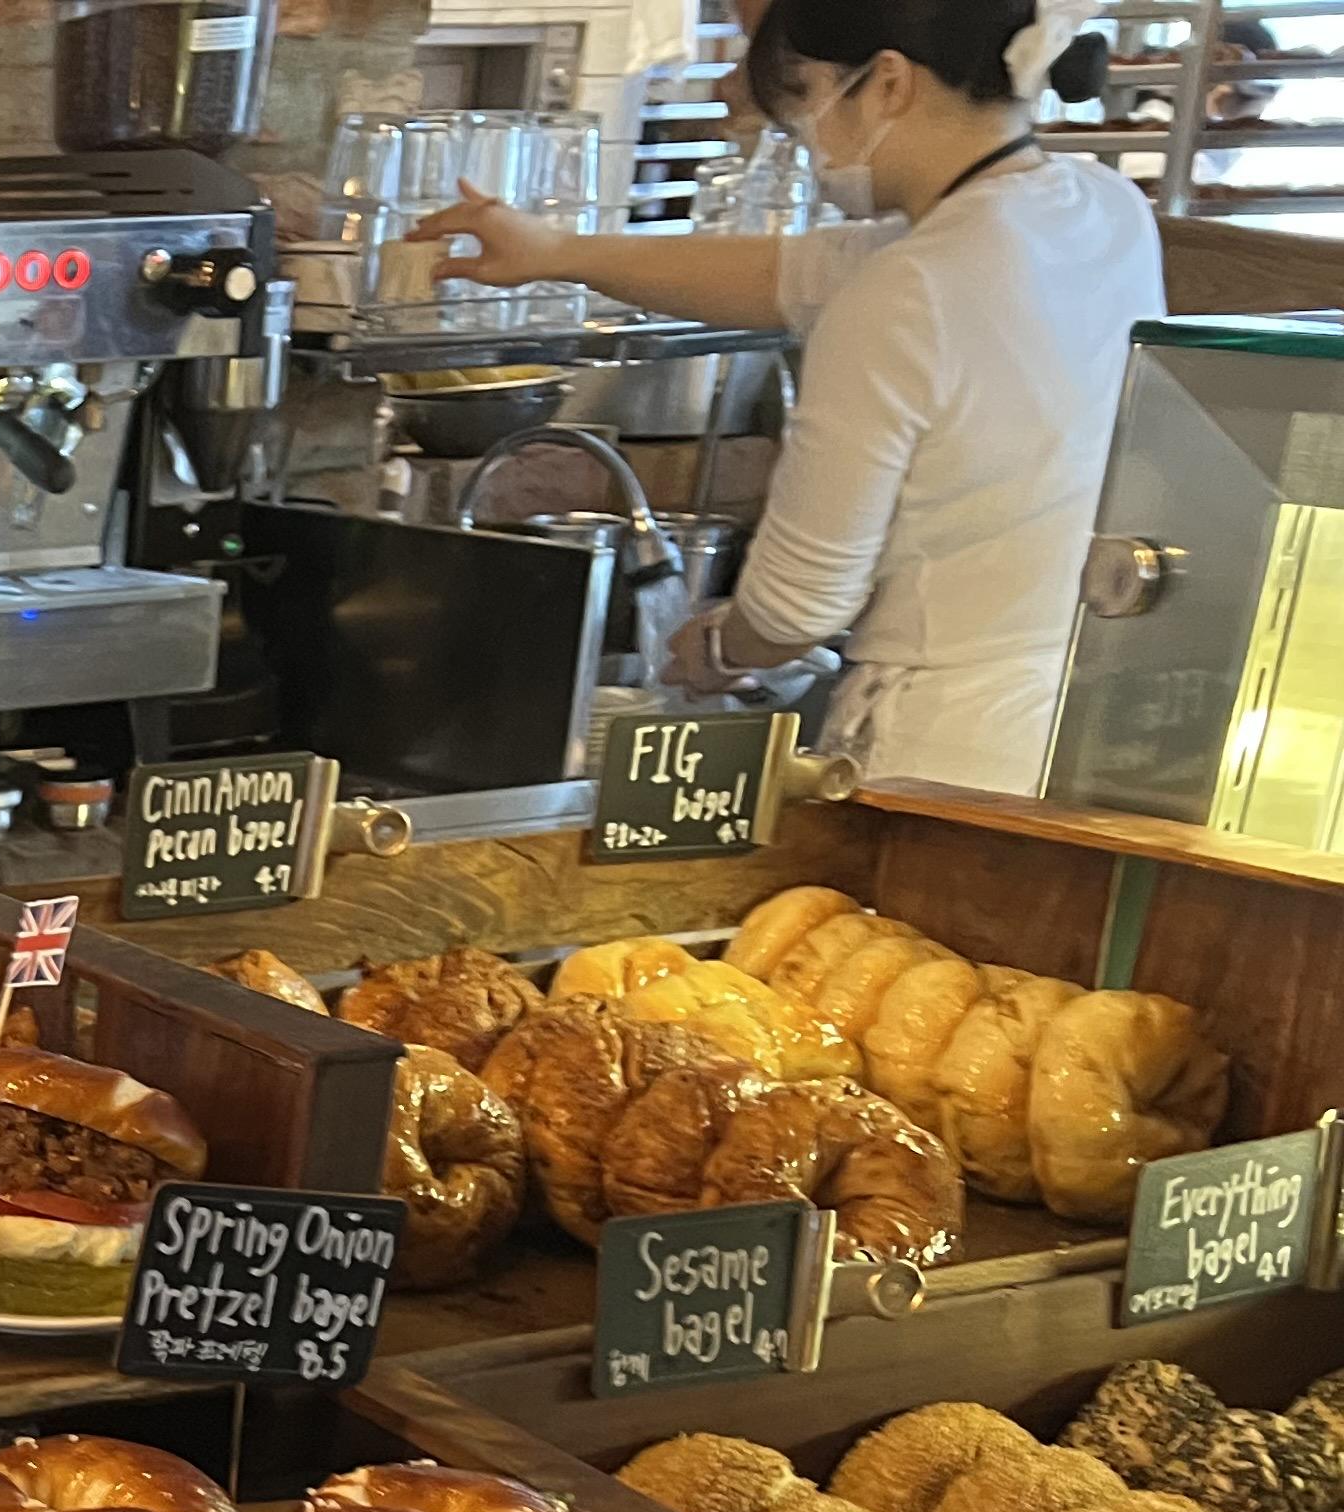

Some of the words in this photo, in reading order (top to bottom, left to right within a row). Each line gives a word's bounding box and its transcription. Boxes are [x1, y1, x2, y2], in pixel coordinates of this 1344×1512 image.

[629, 722, 703, 784] FIG
[226, 799, 303, 857] bagel
[672, 772, 748, 823] bagel
[1159, 1159, 1302, 1238] Everything
[155, 1196, 289, 1277] Spring
[295, 1205, 395, 1270] Onion
[634, 1231, 769, 1302] Sesame
[1187, 1220, 1258, 1284] bagel
[290, 1272, 386, 1342] bagel
[663, 1290, 754, 1363] bagel
[296, 1339, 350, 1380] 8.5
